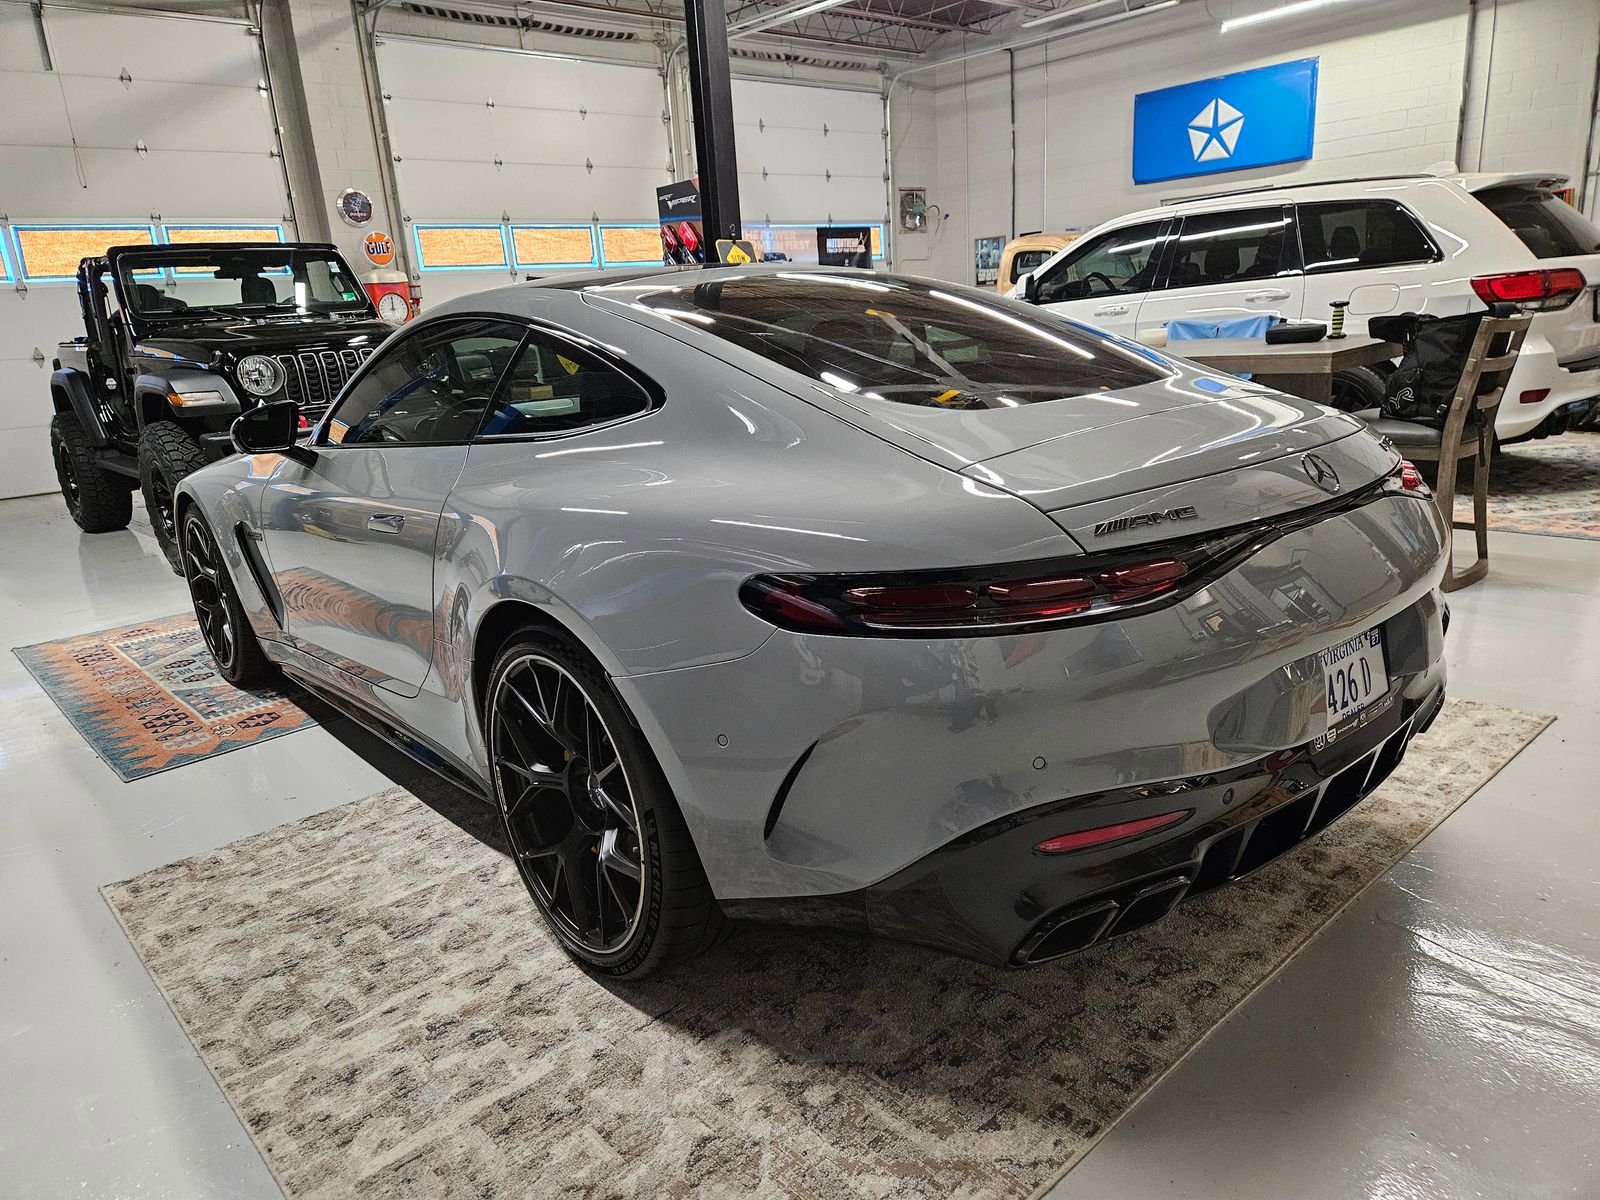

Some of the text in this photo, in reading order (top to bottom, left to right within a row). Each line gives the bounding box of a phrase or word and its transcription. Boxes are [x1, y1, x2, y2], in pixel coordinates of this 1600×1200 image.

[659, 193, 673, 201] SRT
[666, 194, 697, 210] VIPER
[760, 230, 796, 240] POWER
[367, 241, 391, 255] GULF
[785, 240, 810, 250] FIRST
[1322, 635, 1364, 667] VIRGINIA
[1327, 657, 1372, 716] 426 D
[1342, 703, 1365, 721] DEALER
[650, 842, 662, 930] MICHELIN
